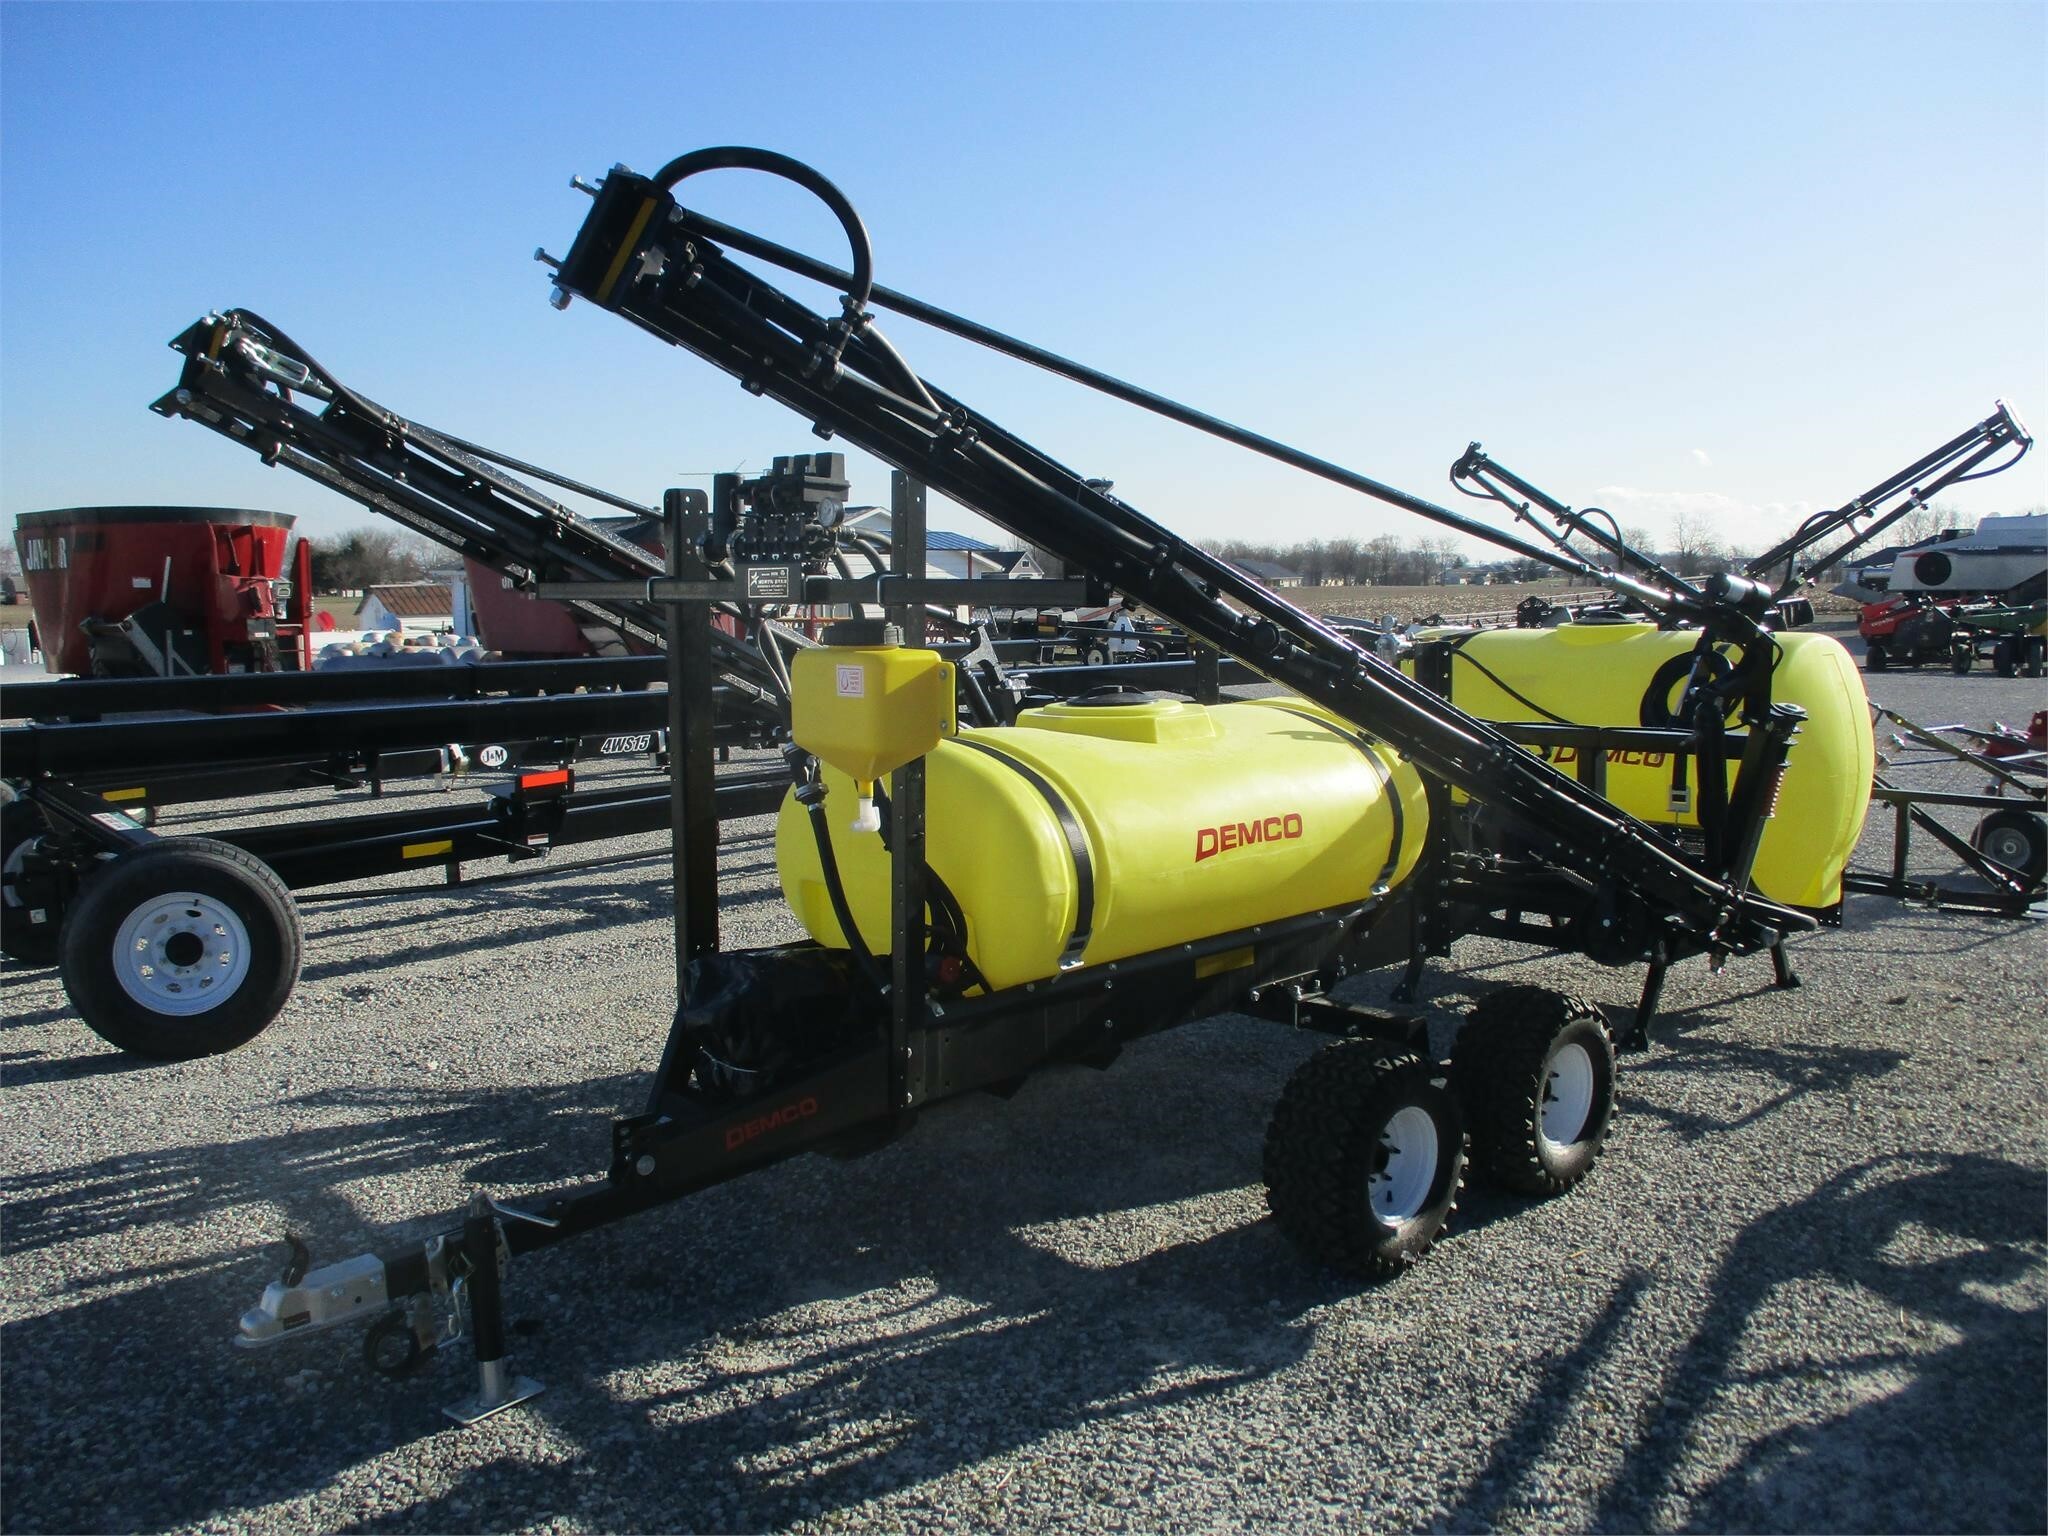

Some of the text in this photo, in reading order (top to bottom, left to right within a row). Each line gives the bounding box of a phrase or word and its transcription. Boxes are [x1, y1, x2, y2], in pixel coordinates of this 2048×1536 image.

[481, 748, 505, 763] J&M
[601, 735, 650, 754] 4WS15
[1195, 812, 1303, 863] DEMCO
[724, 1097, 818, 1152] DEMCO
